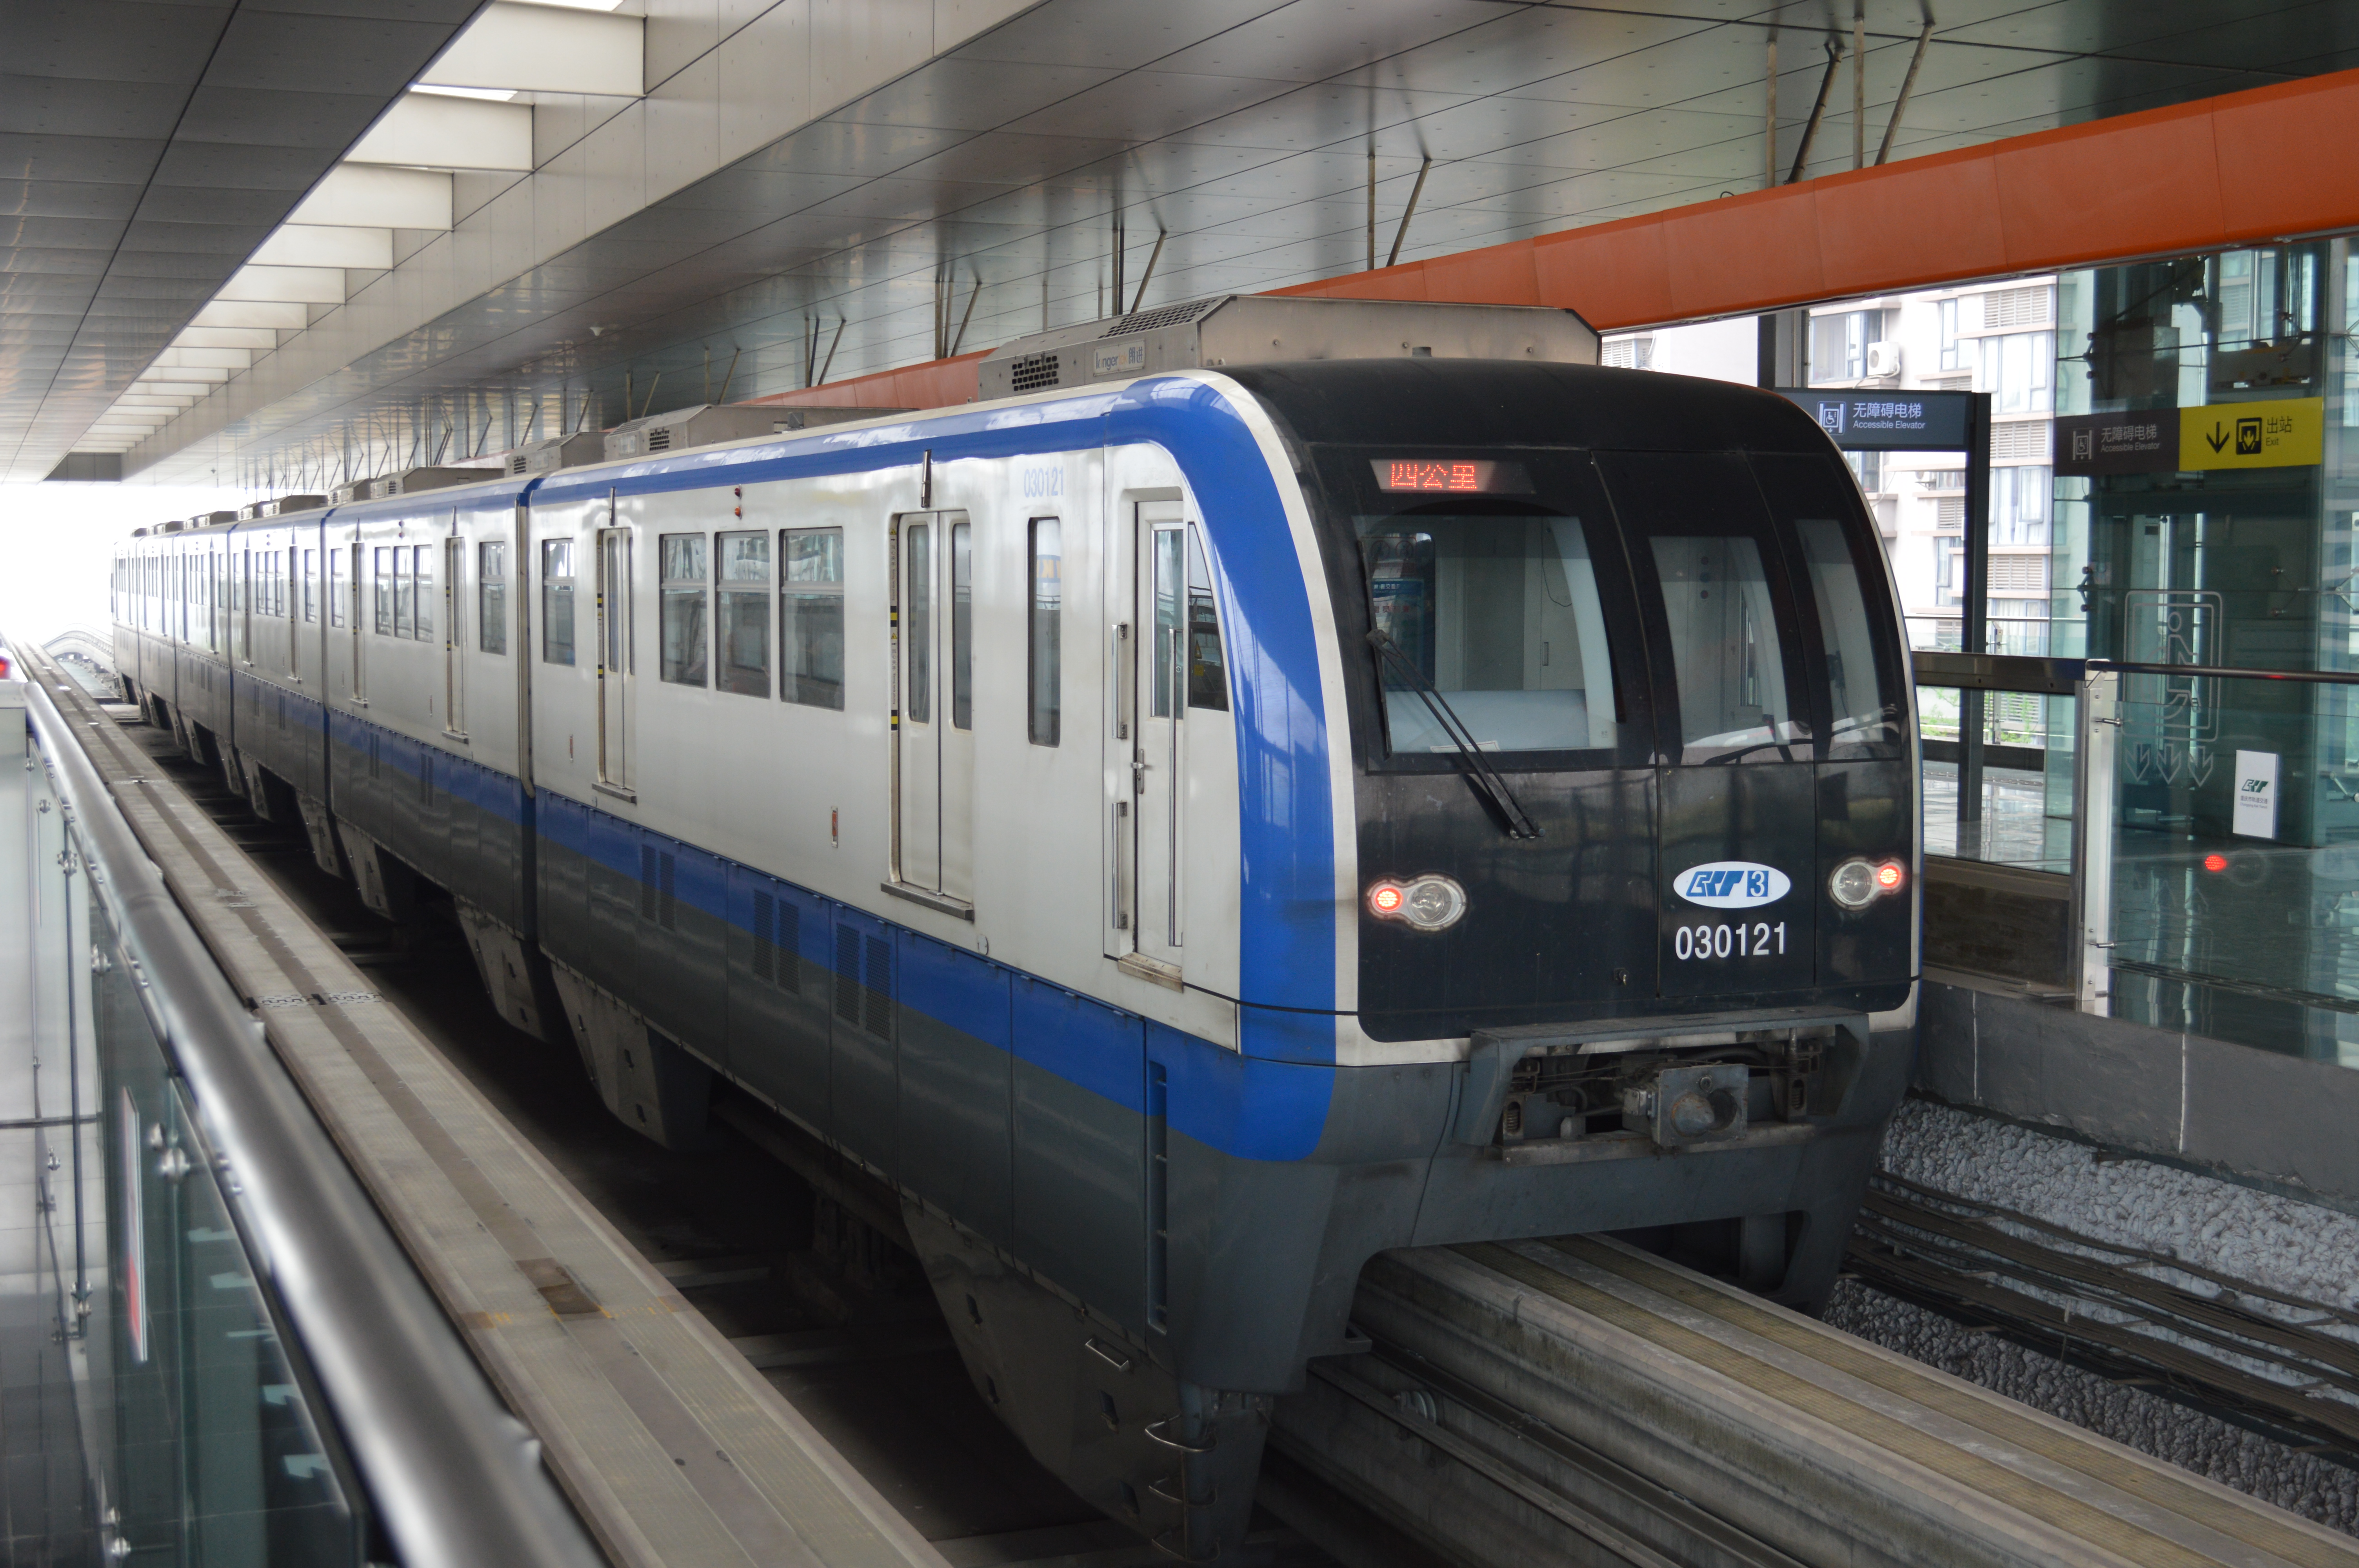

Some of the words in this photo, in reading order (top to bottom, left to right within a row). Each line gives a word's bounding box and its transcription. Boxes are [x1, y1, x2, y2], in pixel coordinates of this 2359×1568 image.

[1853, 402, 1921, 419] 无障碍电梯
[1853, 420, 1893, 429] Accessible
[1895, 421, 1926, 429] Elevator
[2101, 424, 2157, 443] 无障碍电梯
[2267, 416, 2292, 434] 出站
[2101, 443, 2133, 452] Accessible
[2135, 442, 2160, 450] Elevator
[2266, 437, 2279, 446] Exit
[1024, 466, 1063, 498] 030121
[1390, 463, 1477, 488] 四公里
[1750, 871, 1765, 897] 3
[1676, 922, 1784, 960] 030121
